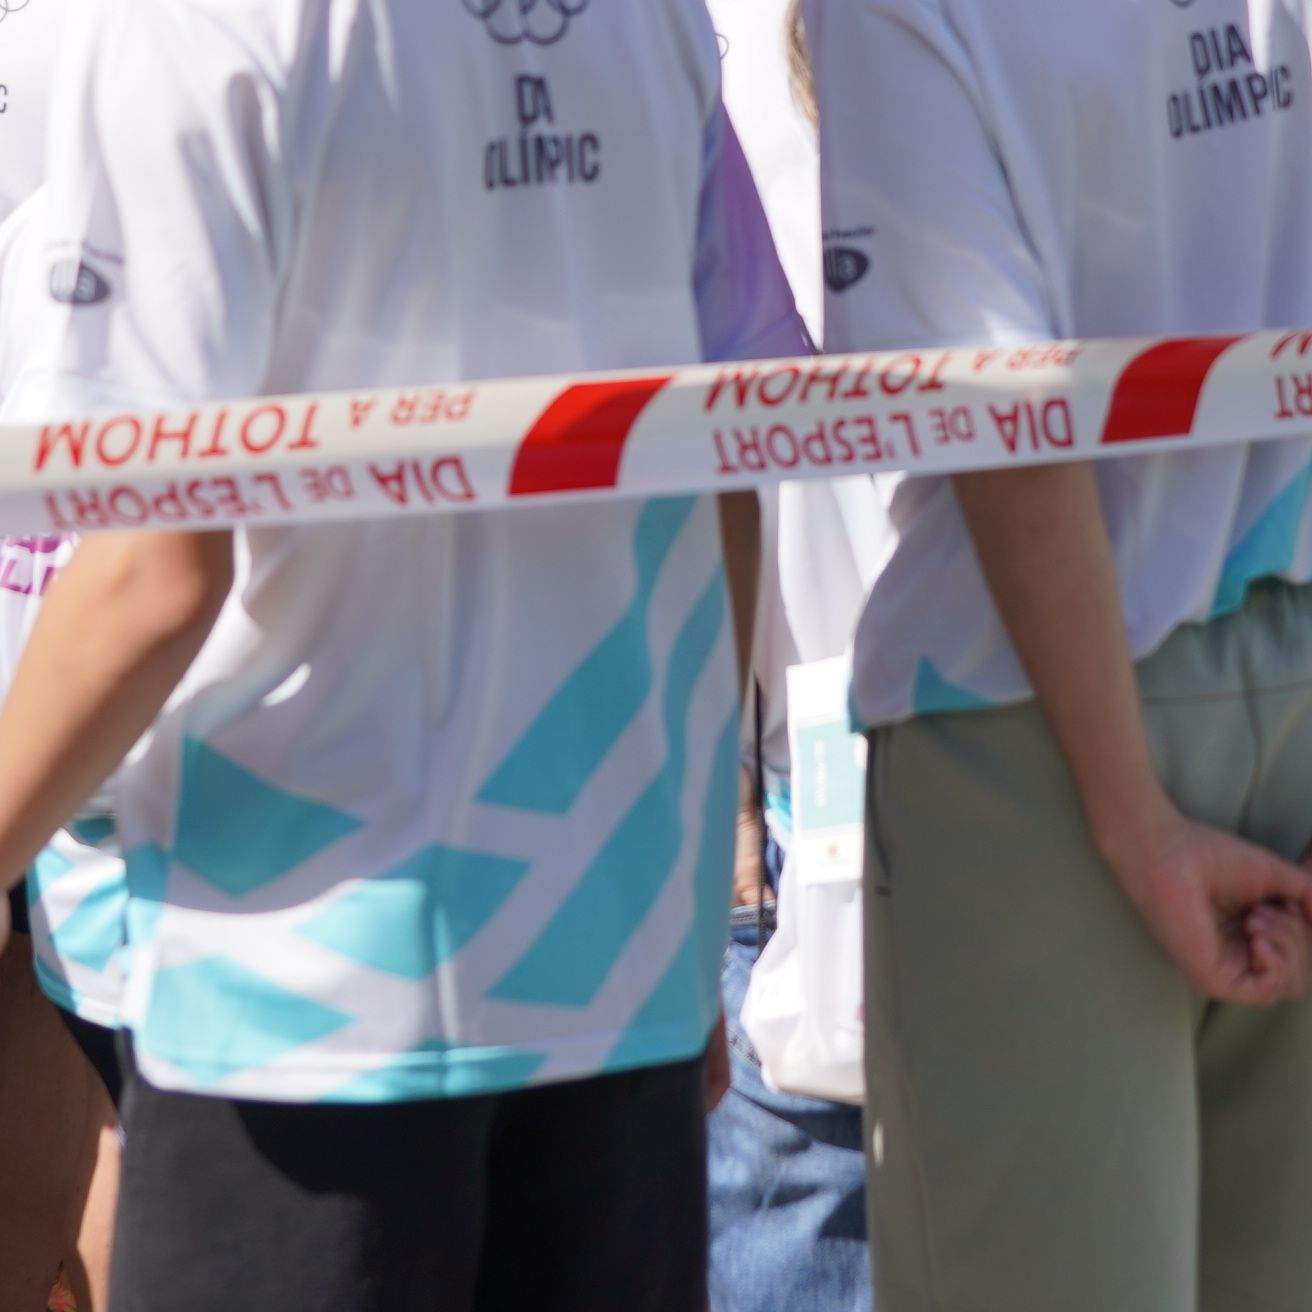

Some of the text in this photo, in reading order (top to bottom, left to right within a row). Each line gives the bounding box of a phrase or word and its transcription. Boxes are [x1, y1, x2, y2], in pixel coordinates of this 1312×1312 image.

[1189, 23, 1253, 77] DIA
[703, 353, 950, 414] TOTHOM
[34, 389, 475, 472] PER A TOTHOM
[712, 397, 1075, 475] DIA DE L'ESPORT
[299, 463, 355, 504] DE
[367, 454, 477, 506] DIA
